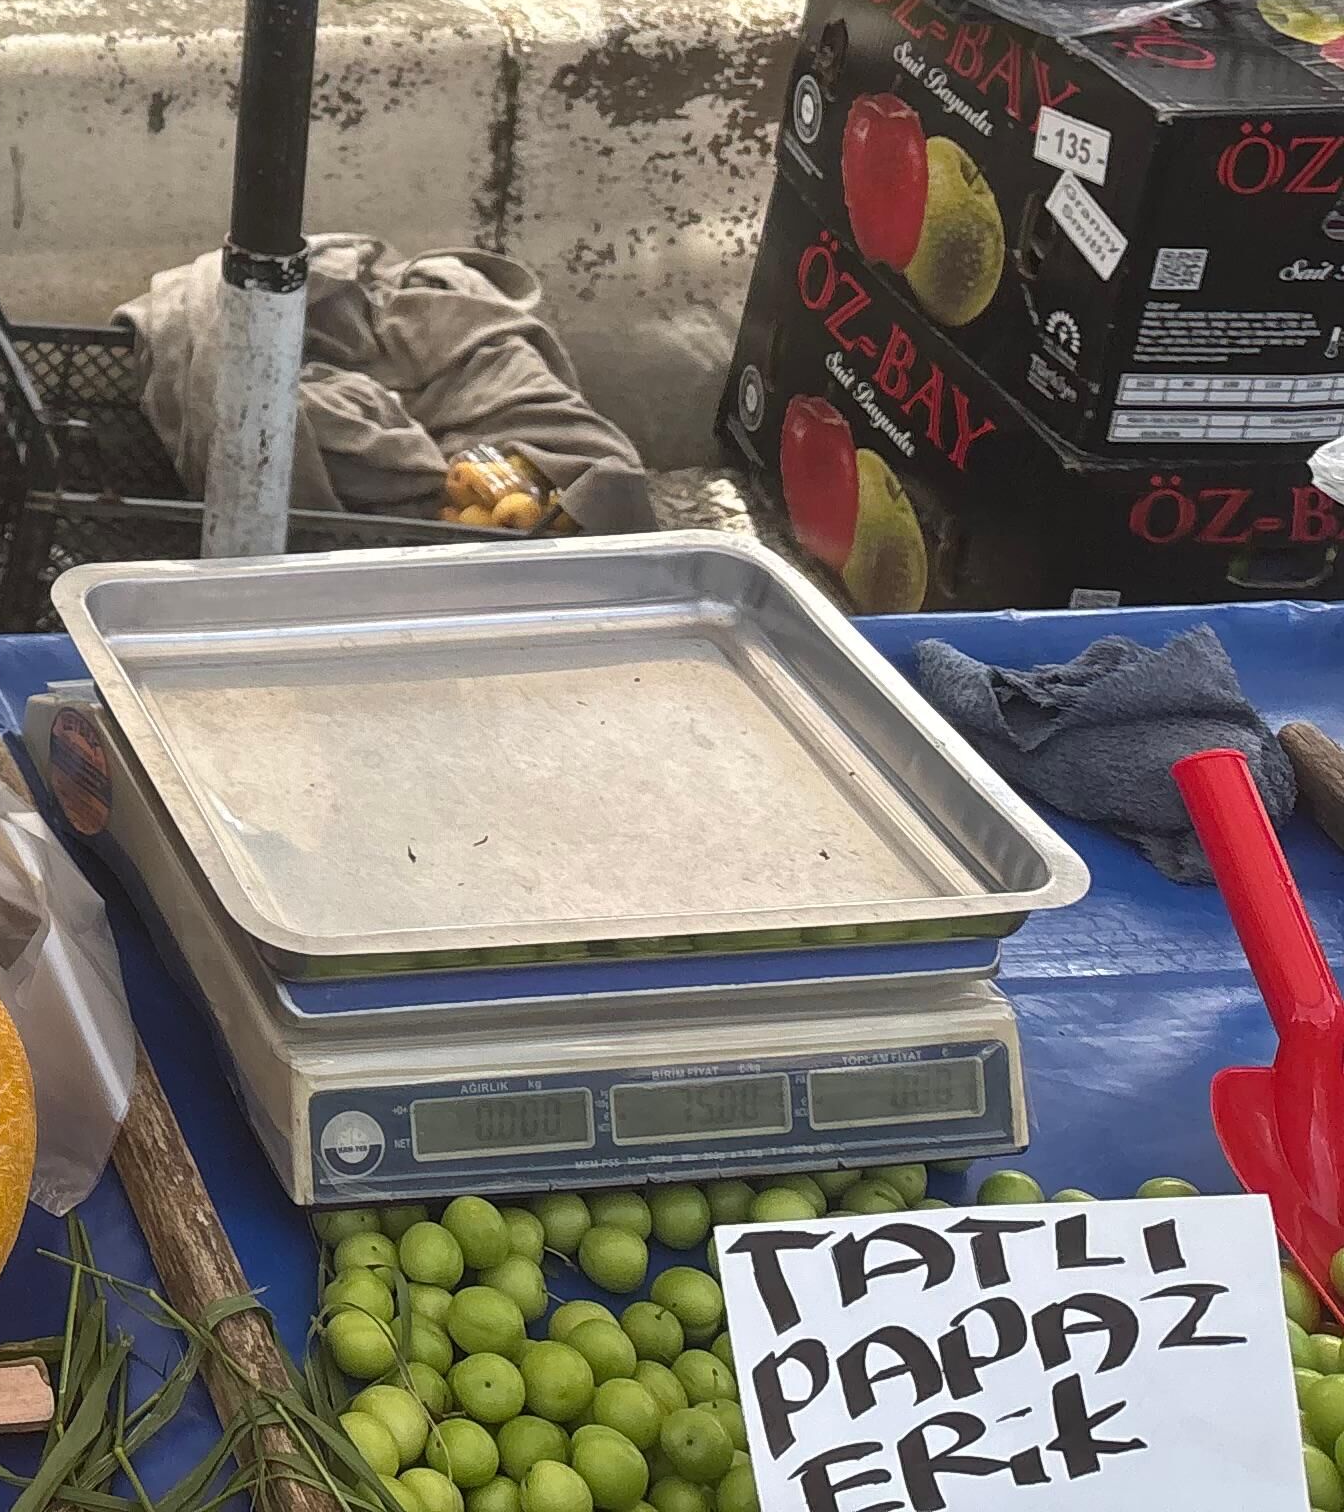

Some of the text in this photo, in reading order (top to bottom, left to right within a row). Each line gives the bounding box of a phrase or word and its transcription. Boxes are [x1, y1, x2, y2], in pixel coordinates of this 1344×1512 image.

[798, 230, 997, 471] ÖZ-BAY
[1129, 474, 1344, 545] ÖZ-B
[724, 1212, 1187, 1336] TATLI
[752, 1282, 1249, 1461] PAPAZ
